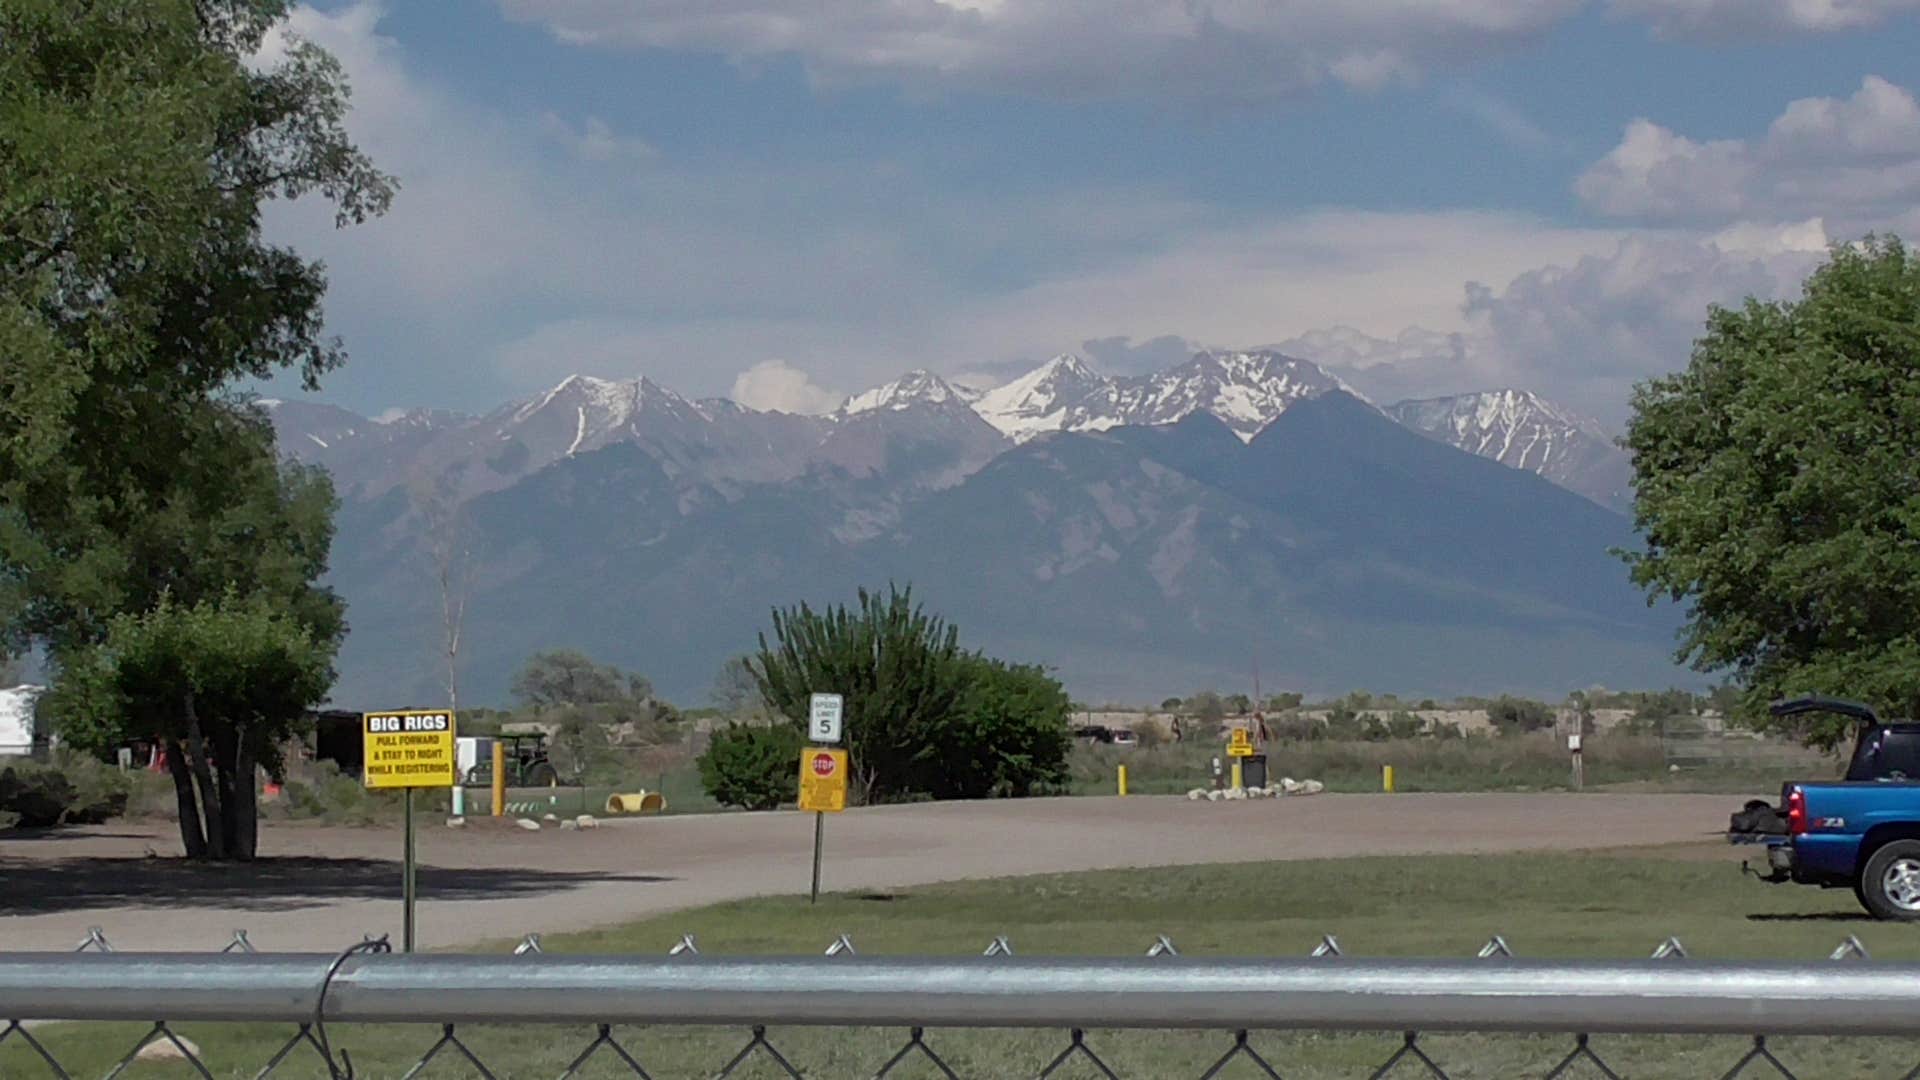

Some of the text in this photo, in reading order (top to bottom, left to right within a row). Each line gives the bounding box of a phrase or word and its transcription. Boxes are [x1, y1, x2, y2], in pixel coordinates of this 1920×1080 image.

[370, 715, 446, 732] BIG RIGS
[820, 719, 831, 734] 5
[376, 735, 440, 746] PULL FORWARD
[382, 750, 402, 760] STAY
[405, 749, 416, 760] TO
[418, 749, 443, 759] RIGHT
[368, 763, 450, 774] WHILE REGISTERING
[813, 759, 835, 770] STOP
